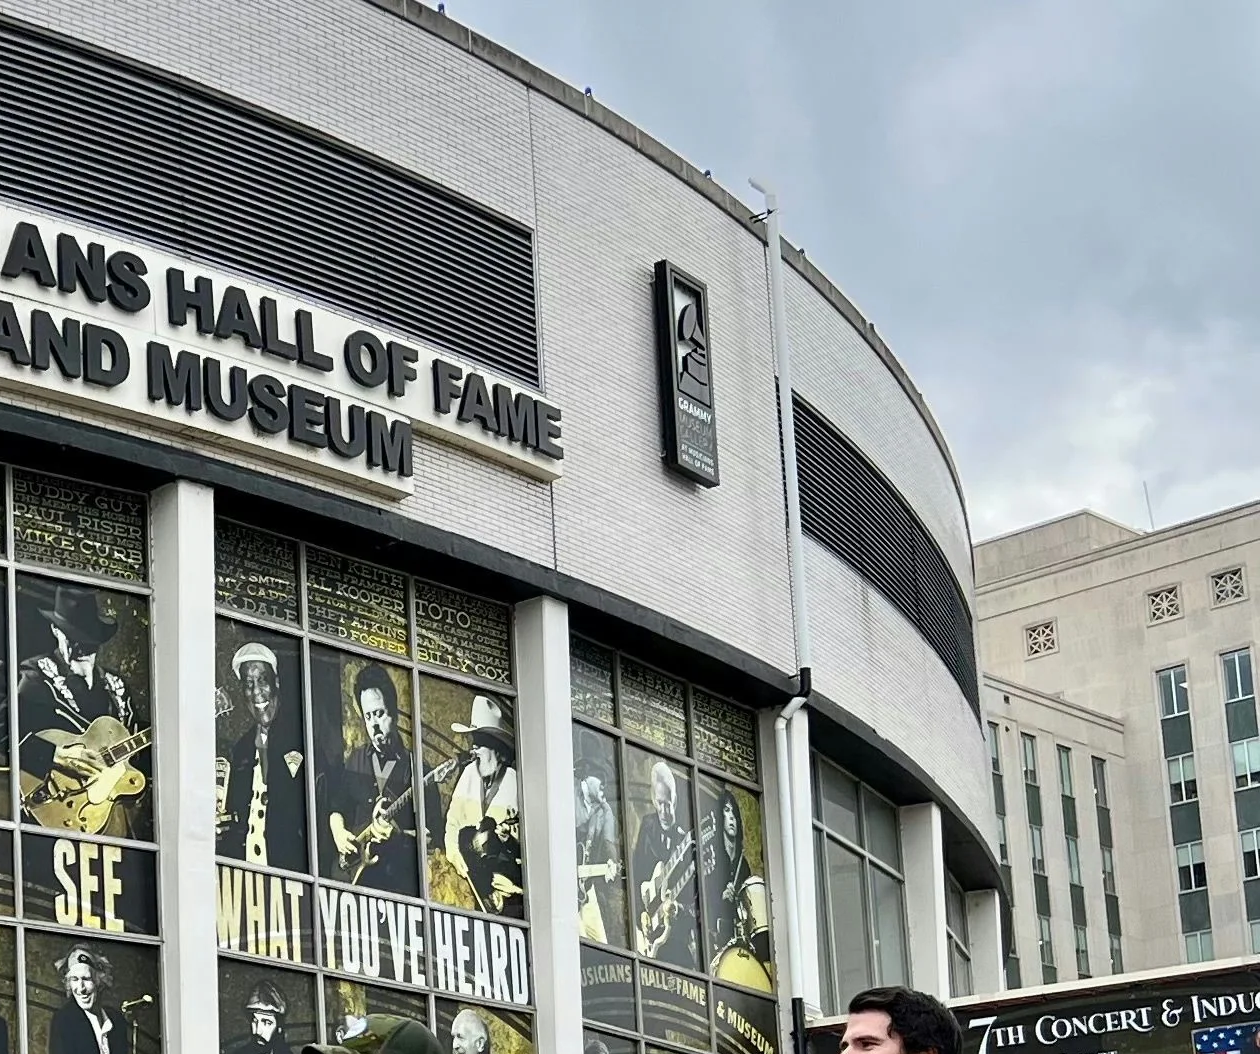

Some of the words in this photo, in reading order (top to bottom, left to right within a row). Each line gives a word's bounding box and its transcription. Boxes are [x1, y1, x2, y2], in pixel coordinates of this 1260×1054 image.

[166, 267, 334, 373] HALL
[344, 329, 419, 399] OF
[431, 358, 564, 461] FAME
[147, 340, 414, 478] MUSEUM
[678, 396, 712, 424] GRAMMY
[14, 478, 91, 505] BUDDY
[95, 496, 141, 516] GUY
[13, 502, 73, 525] PAUL
[77, 514, 141, 540] RISER
[14, 526, 75, 551] MIKE
[79, 540, 143, 563] CURB
[336, 582, 404, 614] KOOPER
[415, 600, 470, 628] TOTO
[350, 629, 406, 656] FOSTER
[351, 617, 407, 640] ATKINS
[475, 664, 510, 684] COX
[53, 838, 125, 933] SEE
[216, 865, 304, 964] WHAT
[318, 886, 426, 986] YOU'VE
[434, 910, 529, 1005] HEARD
[581, 963, 632, 987] USICIANS
[640, 967, 669, 989] HALL
[676, 978, 706, 1007] FAME
[716, 1000, 725, 1020] &
[1034, 1006, 1155, 1046] CONCERT
[1160, 998, 1184, 1028] &
